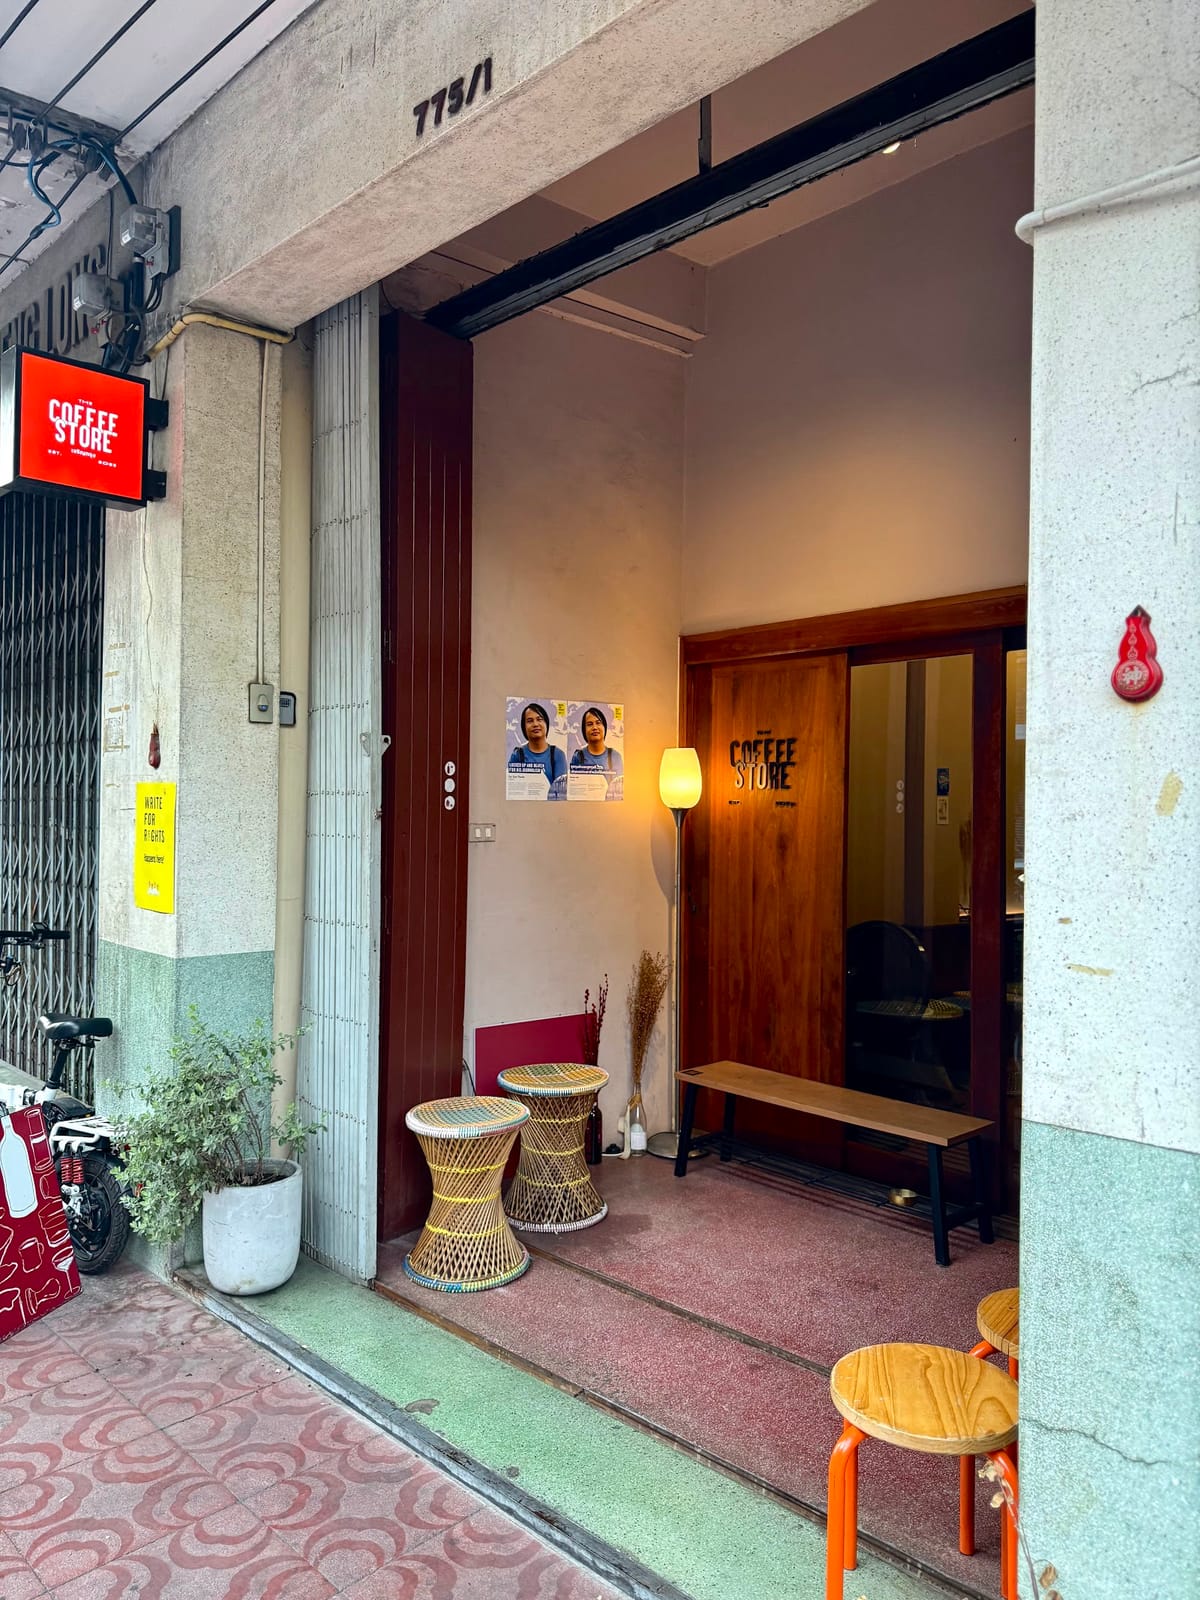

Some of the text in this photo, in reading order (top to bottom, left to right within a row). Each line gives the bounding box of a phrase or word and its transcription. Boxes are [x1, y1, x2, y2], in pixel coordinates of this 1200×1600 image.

[413, 57, 492, 137] 775/1
[49, 398, 119, 437] COFFEE
[55, 418, 112, 454] STORE
[730, 737, 797, 769] COFFEE
[735, 761, 792, 791] STORE
[145, 796, 162, 810] WRITE
[143, 813, 156, 825] FOR
[143, 829, 165, 843] RIGHTS
